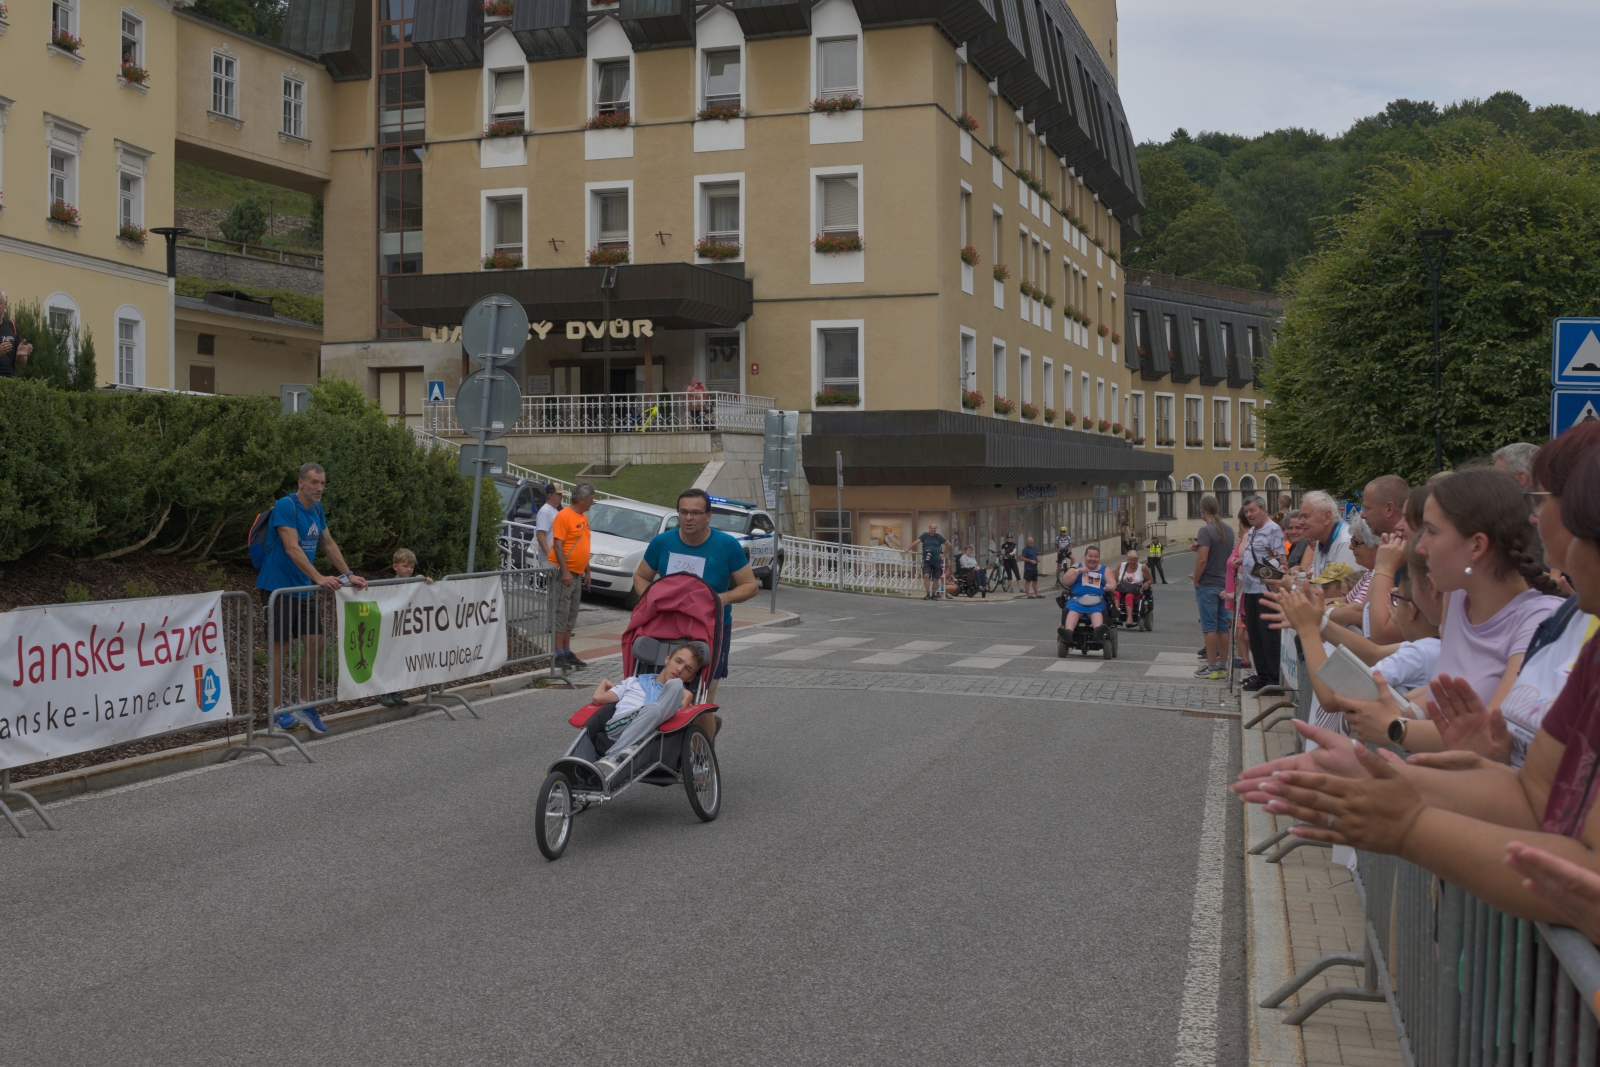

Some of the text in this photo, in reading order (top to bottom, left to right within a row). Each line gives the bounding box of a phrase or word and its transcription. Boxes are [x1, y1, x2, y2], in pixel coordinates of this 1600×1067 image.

[430, 318, 654, 344] JAÝ DVŮR
[673, 560, 695, 571] 206
[391, 596, 498, 637] MĚSTO ÚPICE
[12, 607, 218, 687] Janské Lázně
[405, 644, 483, 673] www.upice.cz
[0, 683, 186, 740] anske-lazne.cz
